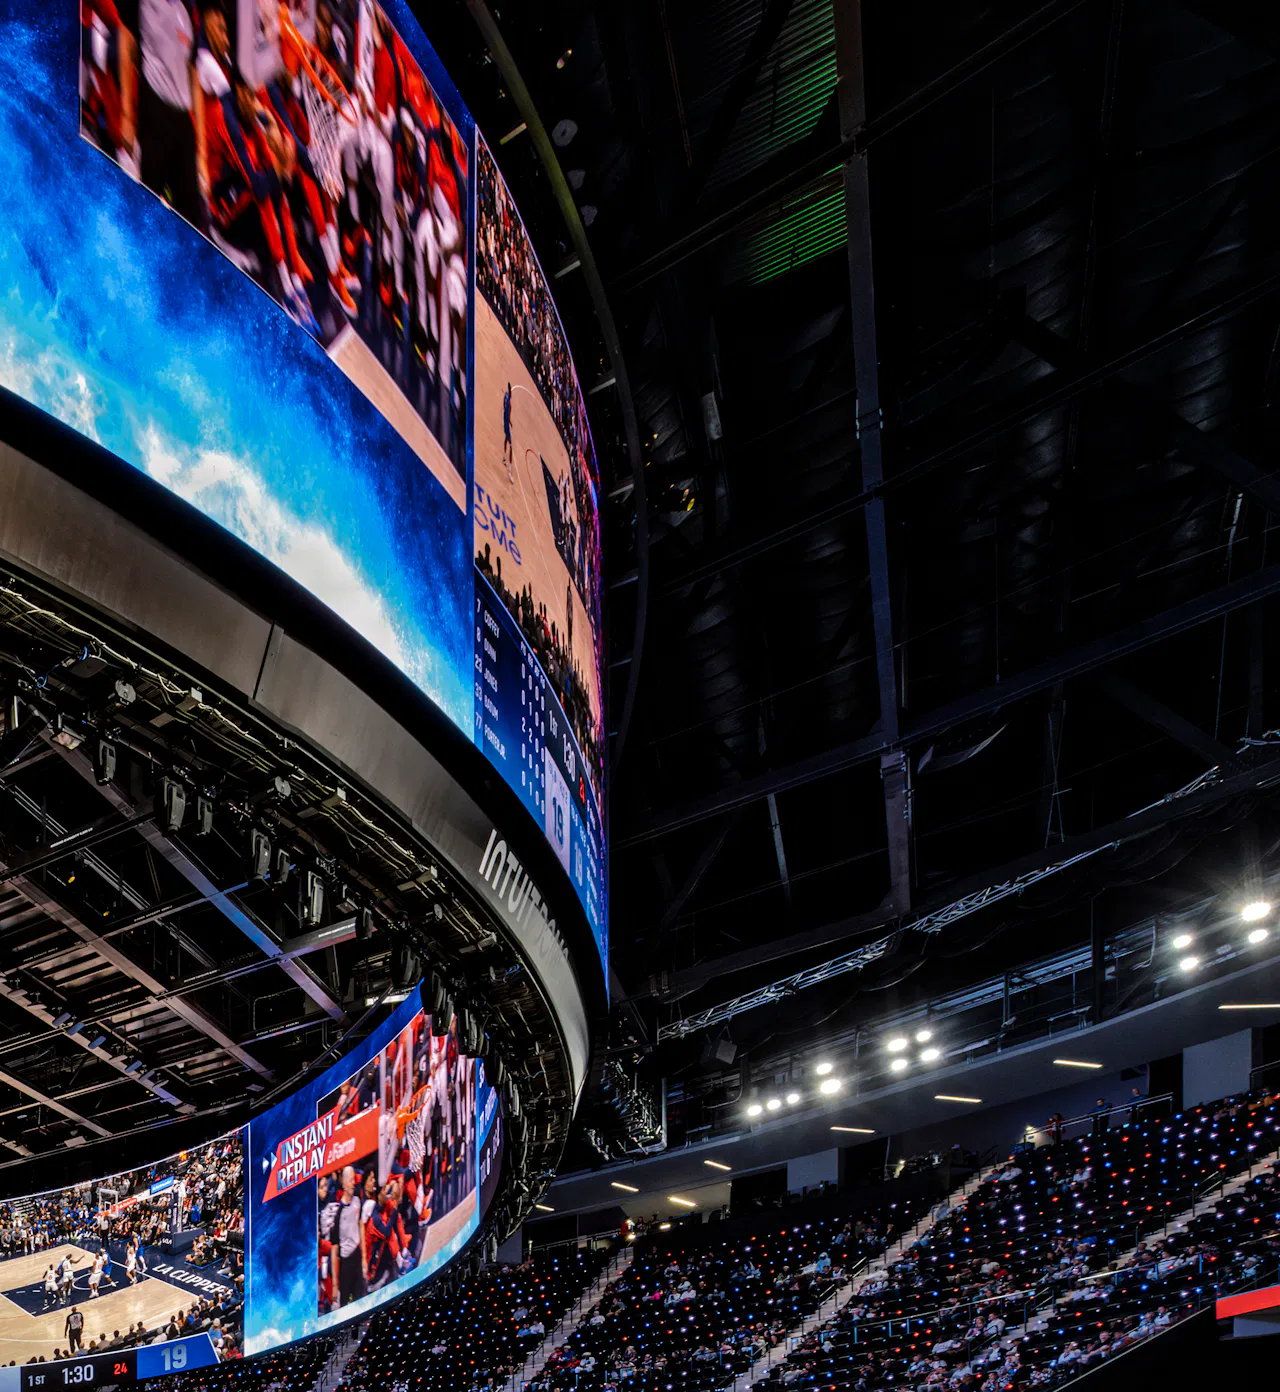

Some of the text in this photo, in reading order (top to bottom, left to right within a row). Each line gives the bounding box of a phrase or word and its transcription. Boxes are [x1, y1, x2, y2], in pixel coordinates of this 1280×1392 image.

[281, 1112, 335, 1168] INSTANT
[276, 1145, 327, 1192] REPLAY
[152, 1263, 170, 1275] LA
[161, 1343, 187, 1371] 19
[62, 1362, 127, 1384] 1:30 24
